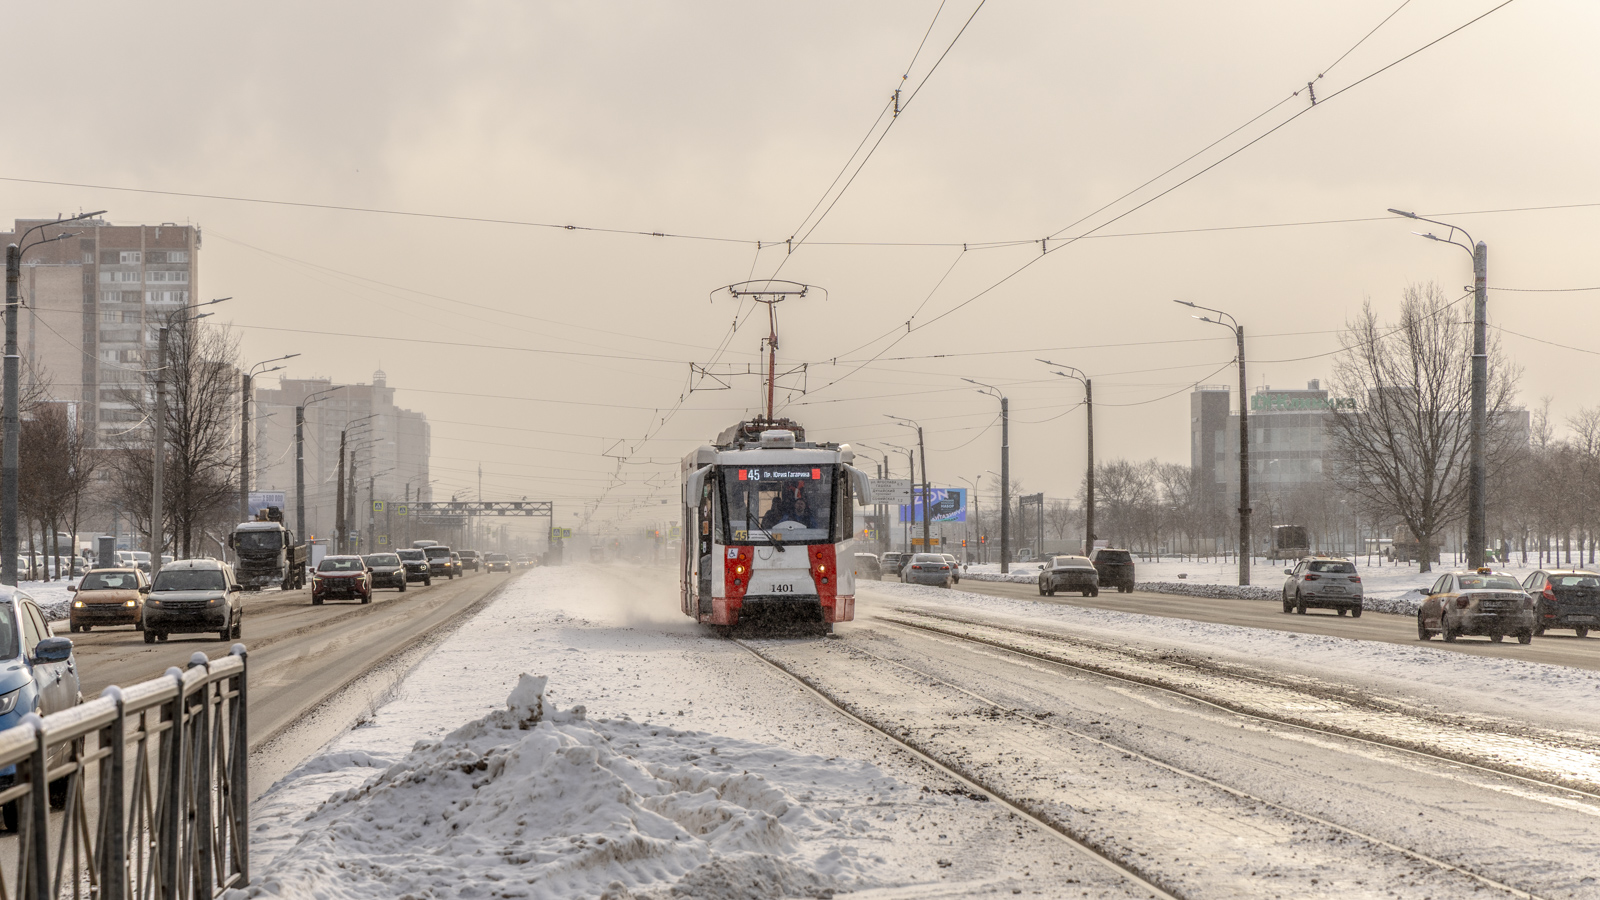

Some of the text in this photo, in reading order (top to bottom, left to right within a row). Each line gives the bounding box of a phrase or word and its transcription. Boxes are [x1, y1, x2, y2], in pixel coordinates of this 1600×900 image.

[747, 469, 760, 481] 45
[734, 531, 747, 541] 45
[771, 584, 794, 593] 1401
